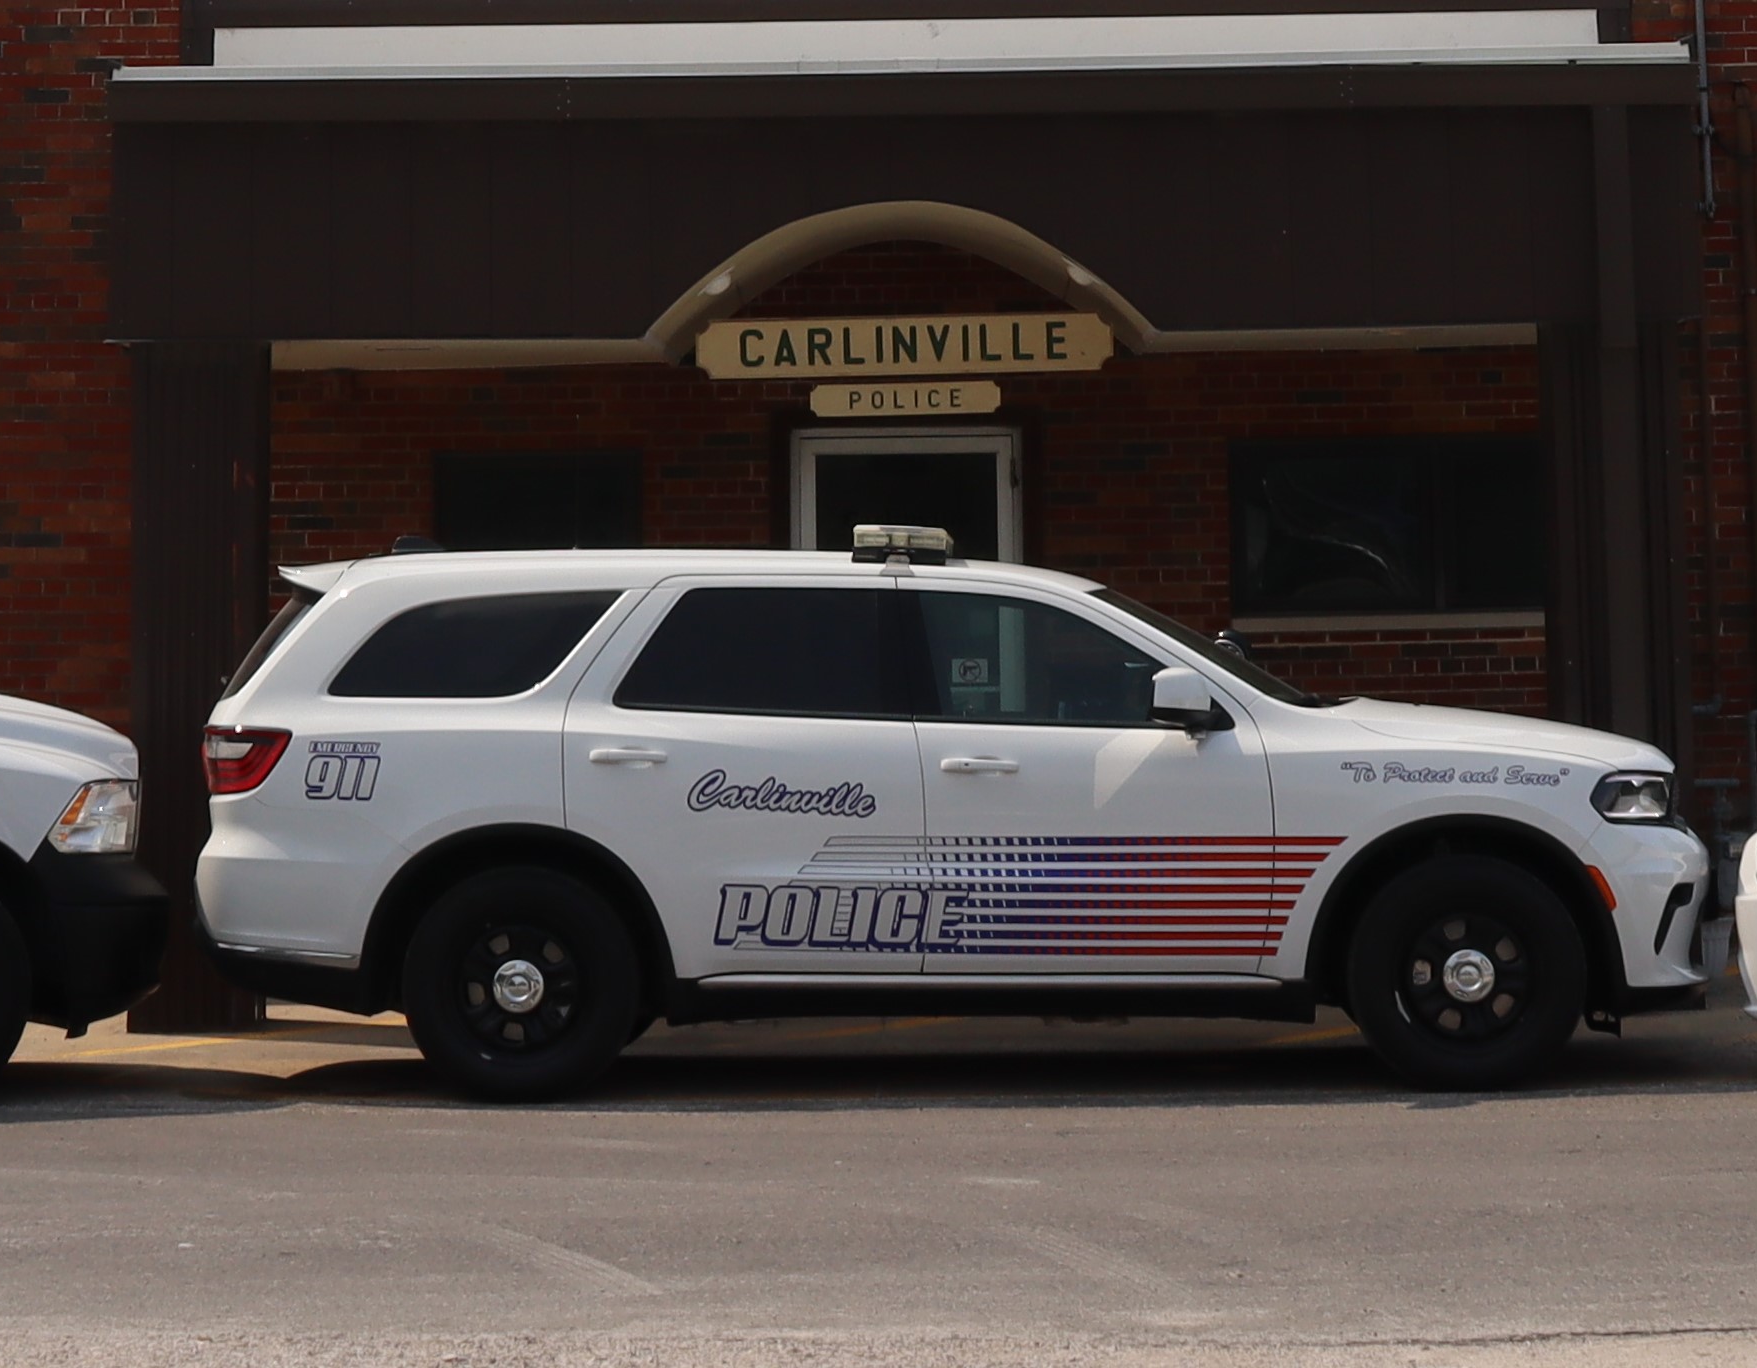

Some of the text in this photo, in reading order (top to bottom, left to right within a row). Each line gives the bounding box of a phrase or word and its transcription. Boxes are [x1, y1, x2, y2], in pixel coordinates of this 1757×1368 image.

[739, 321, 1067, 367] CARLINVILLE
[848, 388, 962, 409] POLICE
[304, 754, 381, 801] 911
[687, 769, 876, 818] Carlinville
[1383, 761, 1455, 784] Protect
[1459, 766, 1499, 785] and
[713, 884, 969, 948] POLICE
